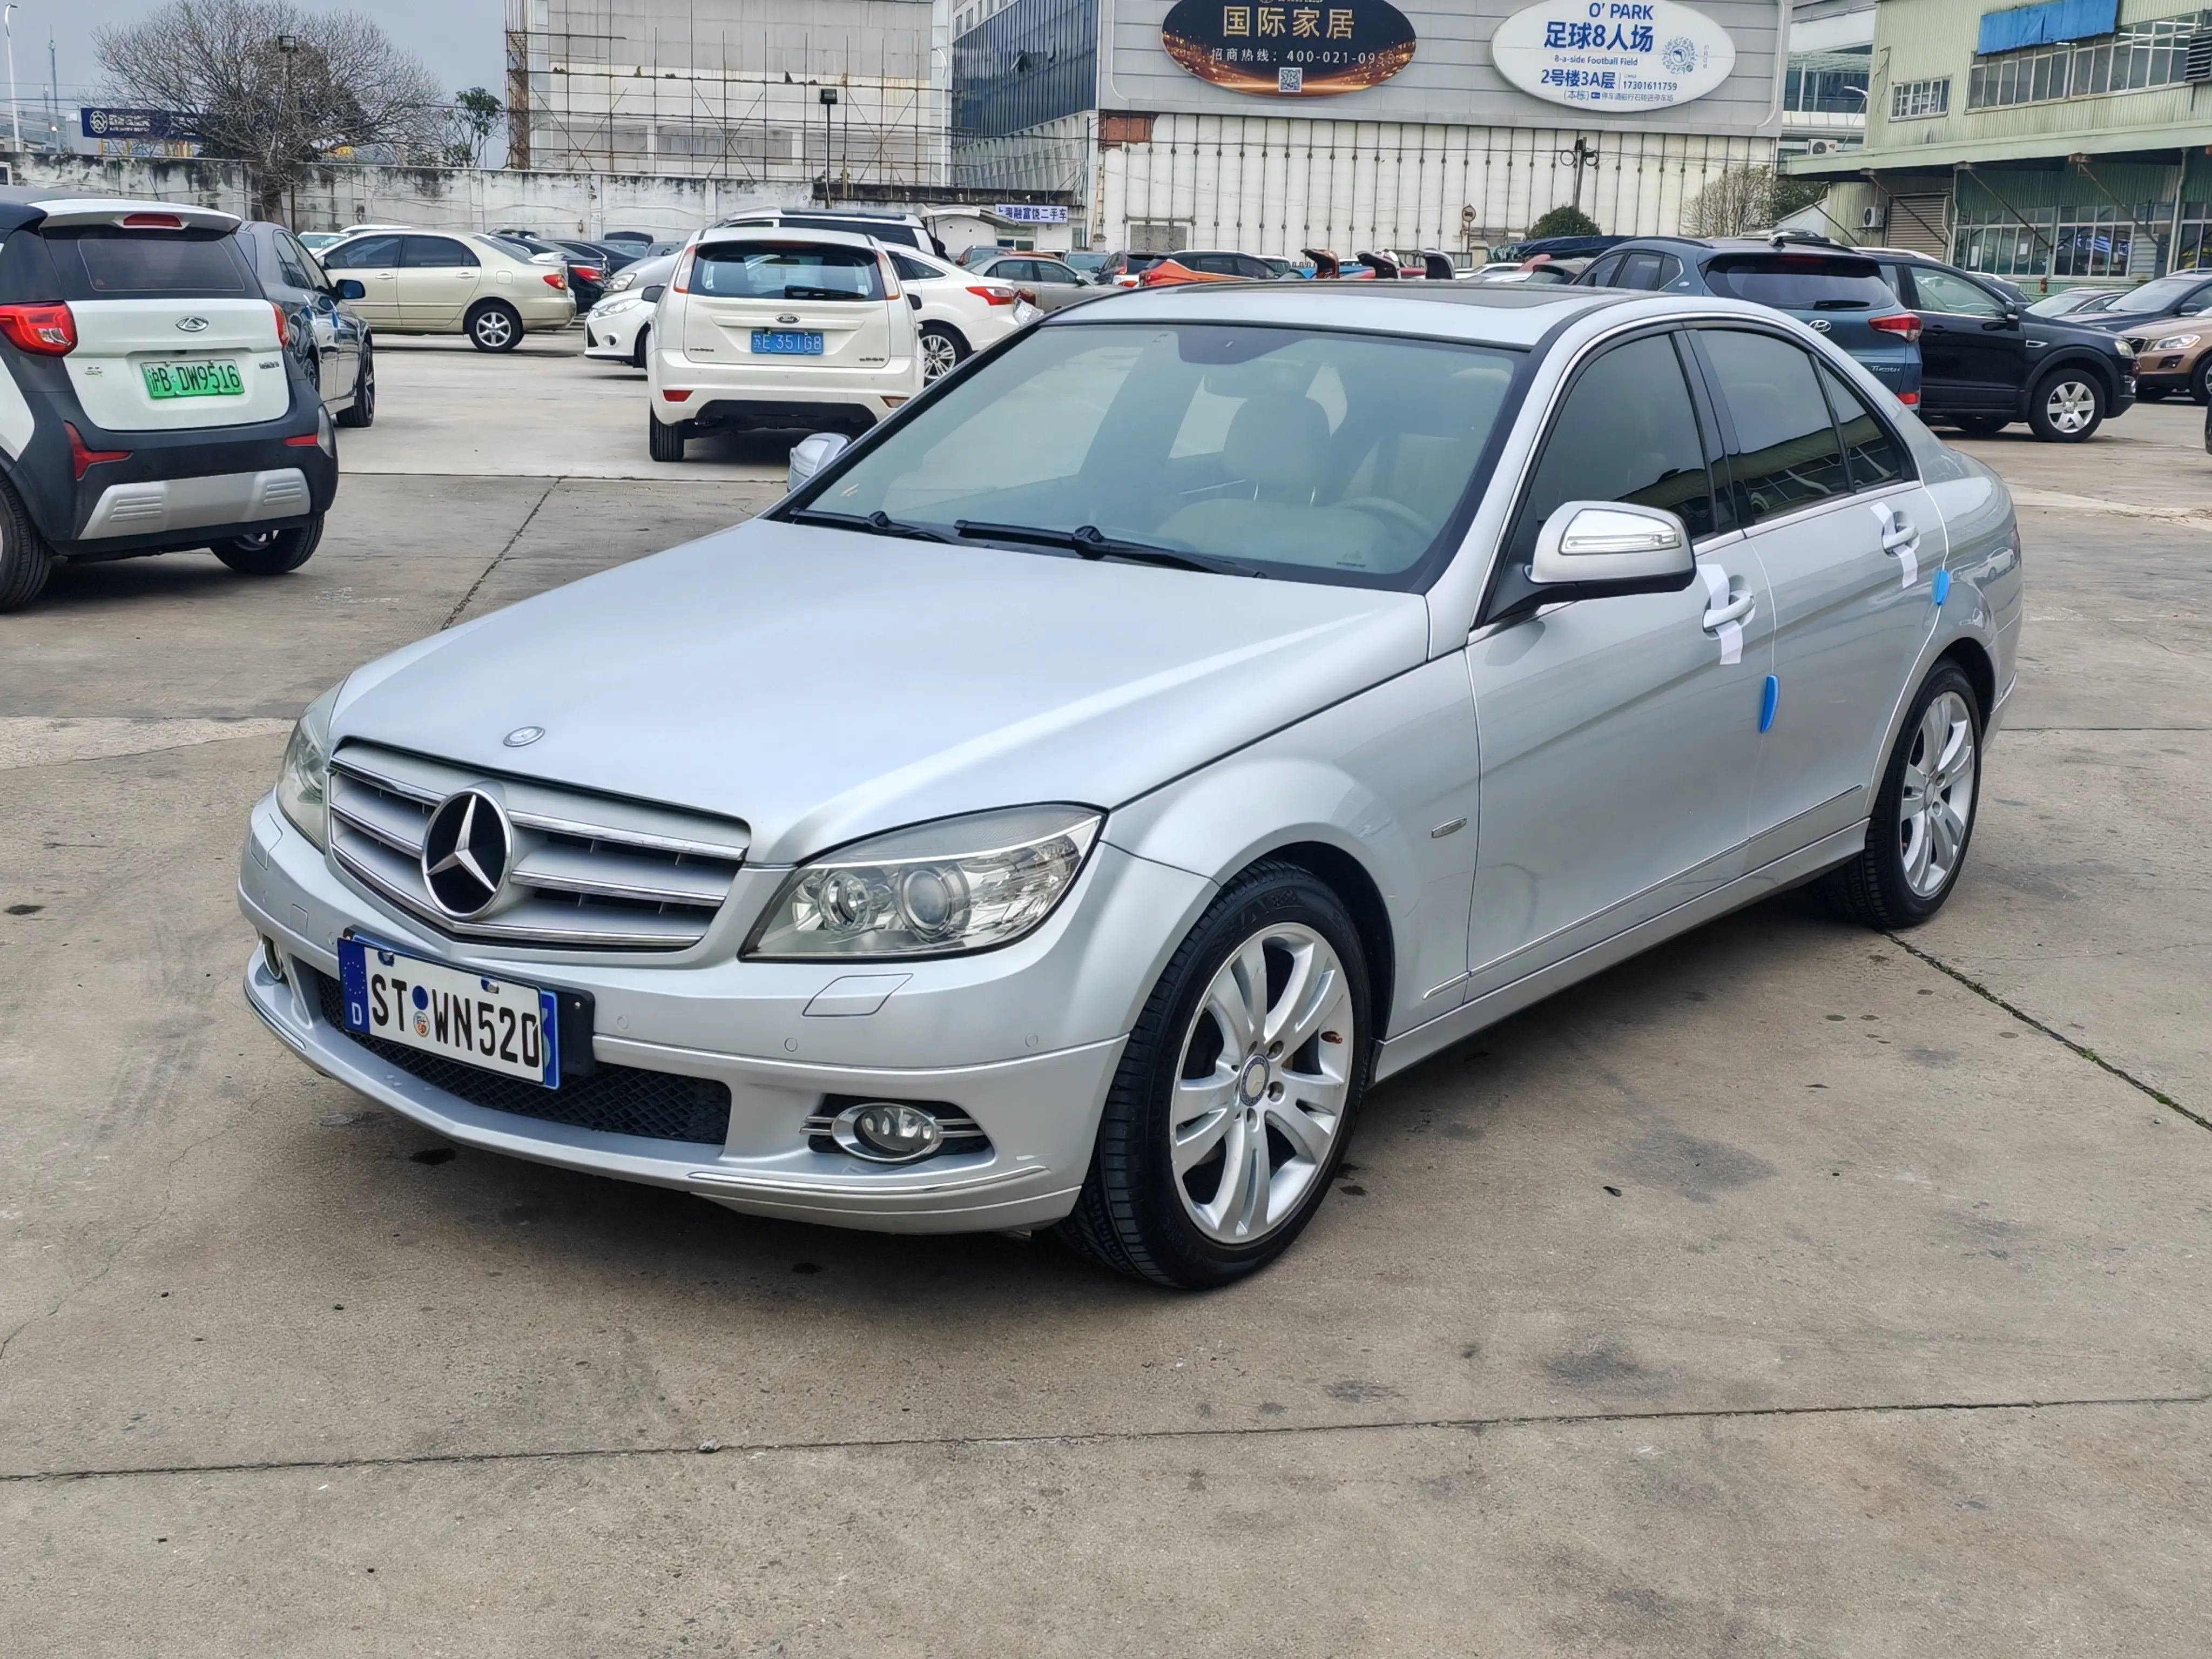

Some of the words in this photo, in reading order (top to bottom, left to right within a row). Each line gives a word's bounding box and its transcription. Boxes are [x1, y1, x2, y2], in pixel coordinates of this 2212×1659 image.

[1223, 5, 1354, 39] 国际家居
[1610, 4, 1654, 20] PARK
[1543, 21, 1654, 52] 足球8人场
[1587, 56, 1618, 65] Football
[1620, 57, 1638, 65] Field
[1541, 69, 1616, 89] 2号楼3A层
[1623, 80, 1678, 91] 17301611759
[351, 1001, 362, 1026] D
[371, 973, 407, 1031] ST
